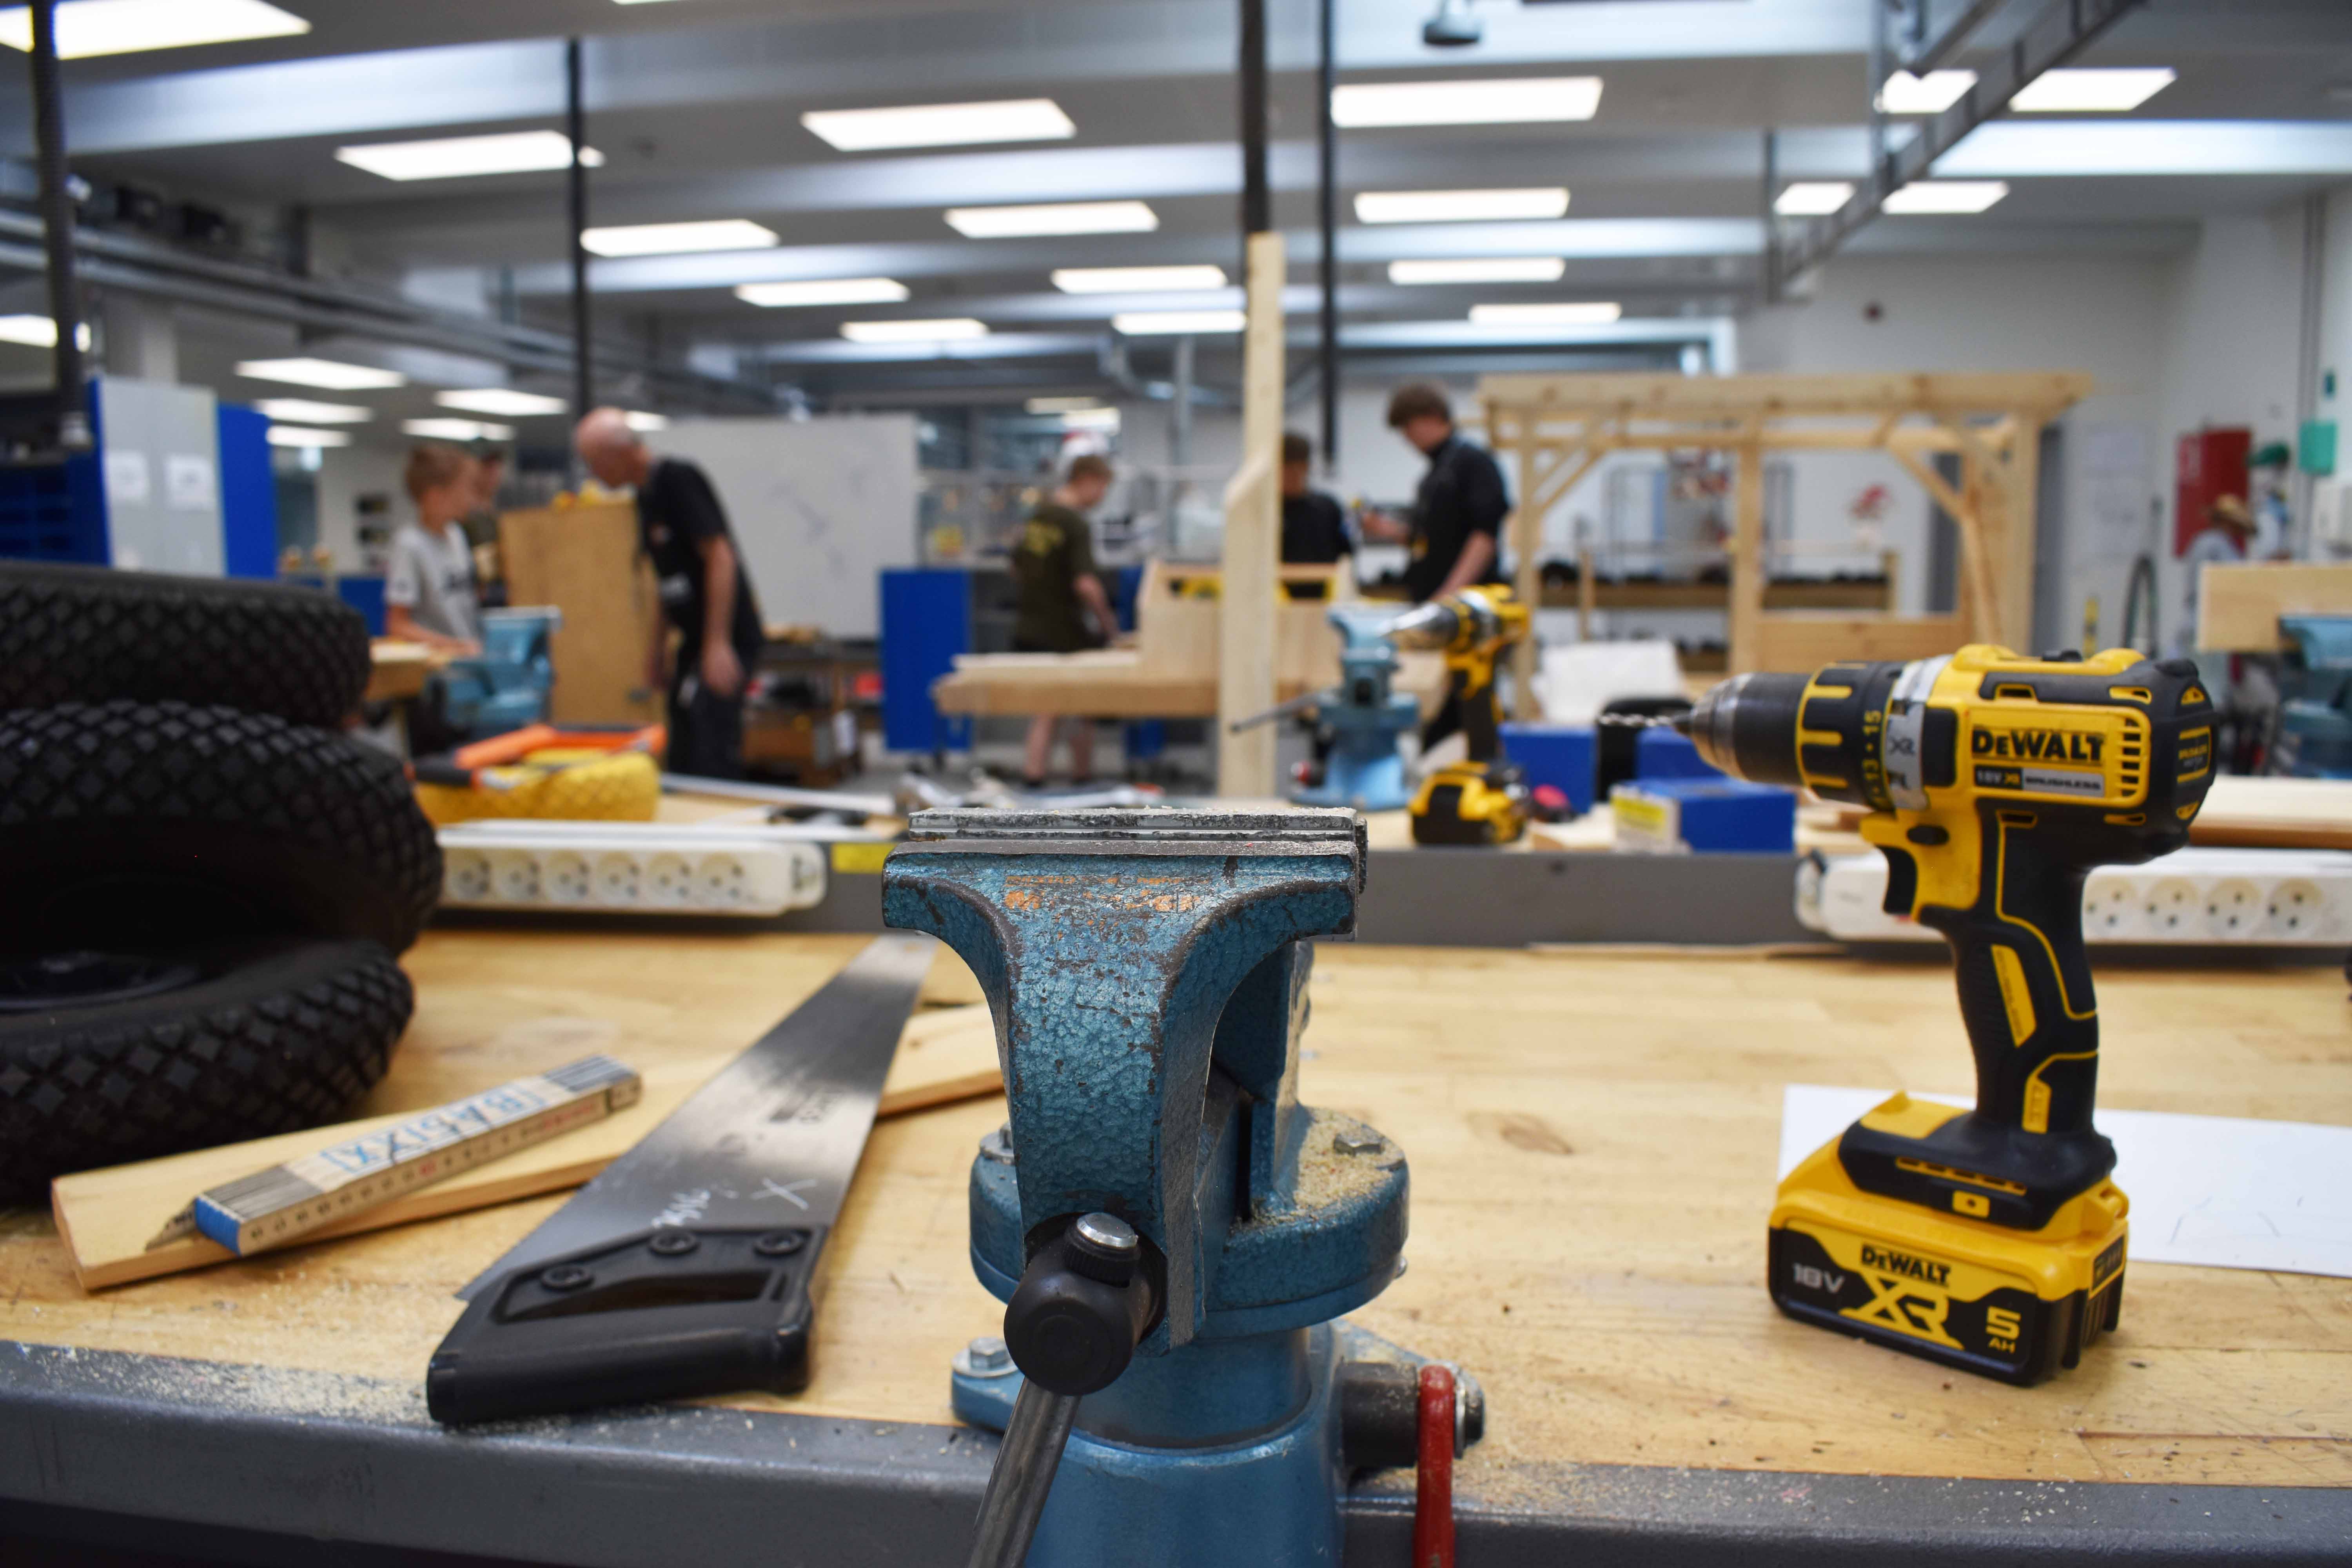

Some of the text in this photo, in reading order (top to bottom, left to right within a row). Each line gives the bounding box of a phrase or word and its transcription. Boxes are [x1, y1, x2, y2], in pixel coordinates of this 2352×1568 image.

[1862, 710, 1881, 736] 15
[1793, 1263, 1844, 1293] 18V
[1839, 1270, 1965, 1351] XR
[1986, 1306, 2022, 1340] 5
[1988, 1338, 2016, 1354] AH
